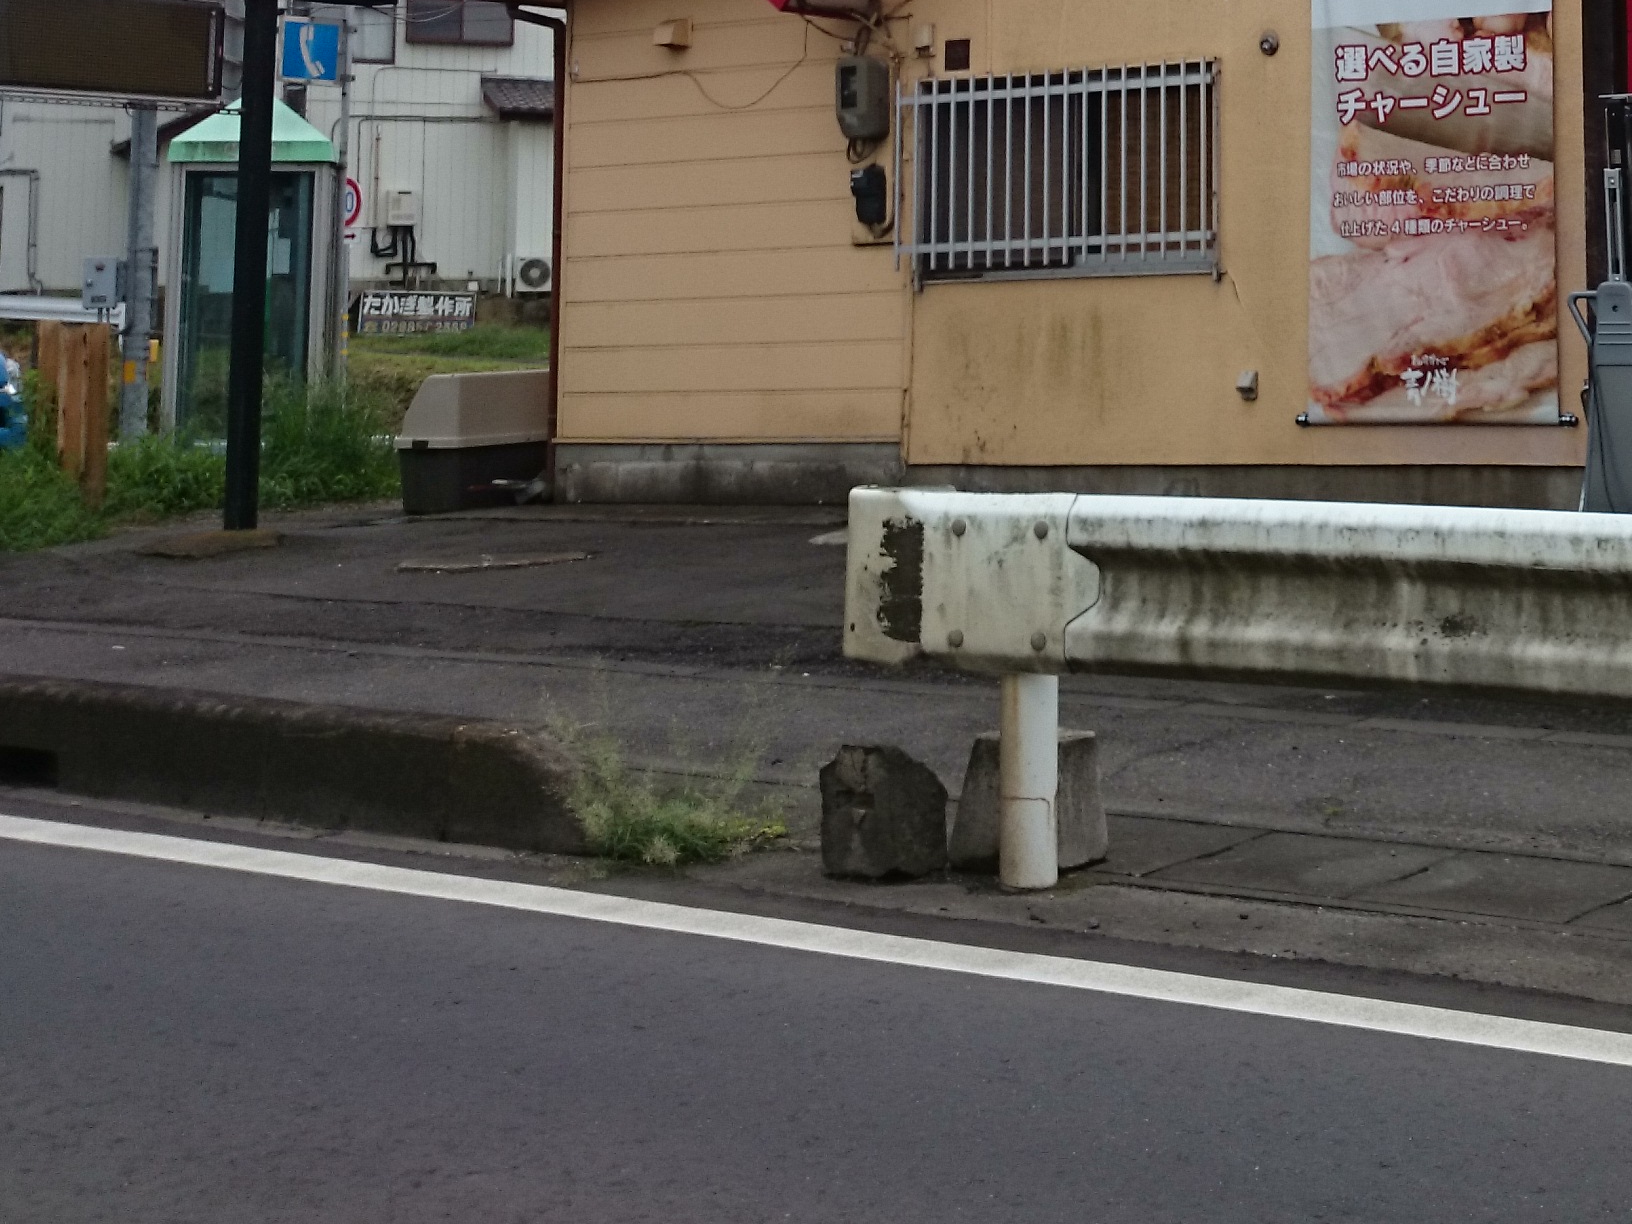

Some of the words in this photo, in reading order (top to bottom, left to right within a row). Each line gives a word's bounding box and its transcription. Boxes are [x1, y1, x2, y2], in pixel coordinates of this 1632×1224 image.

[1334, 34, 1528, 83] 選べる自家製
[1336, 84, 1528, 126] チャーシュー
[1333, 184, 1536, 208] おいしい部位を、こだわりの調理で
